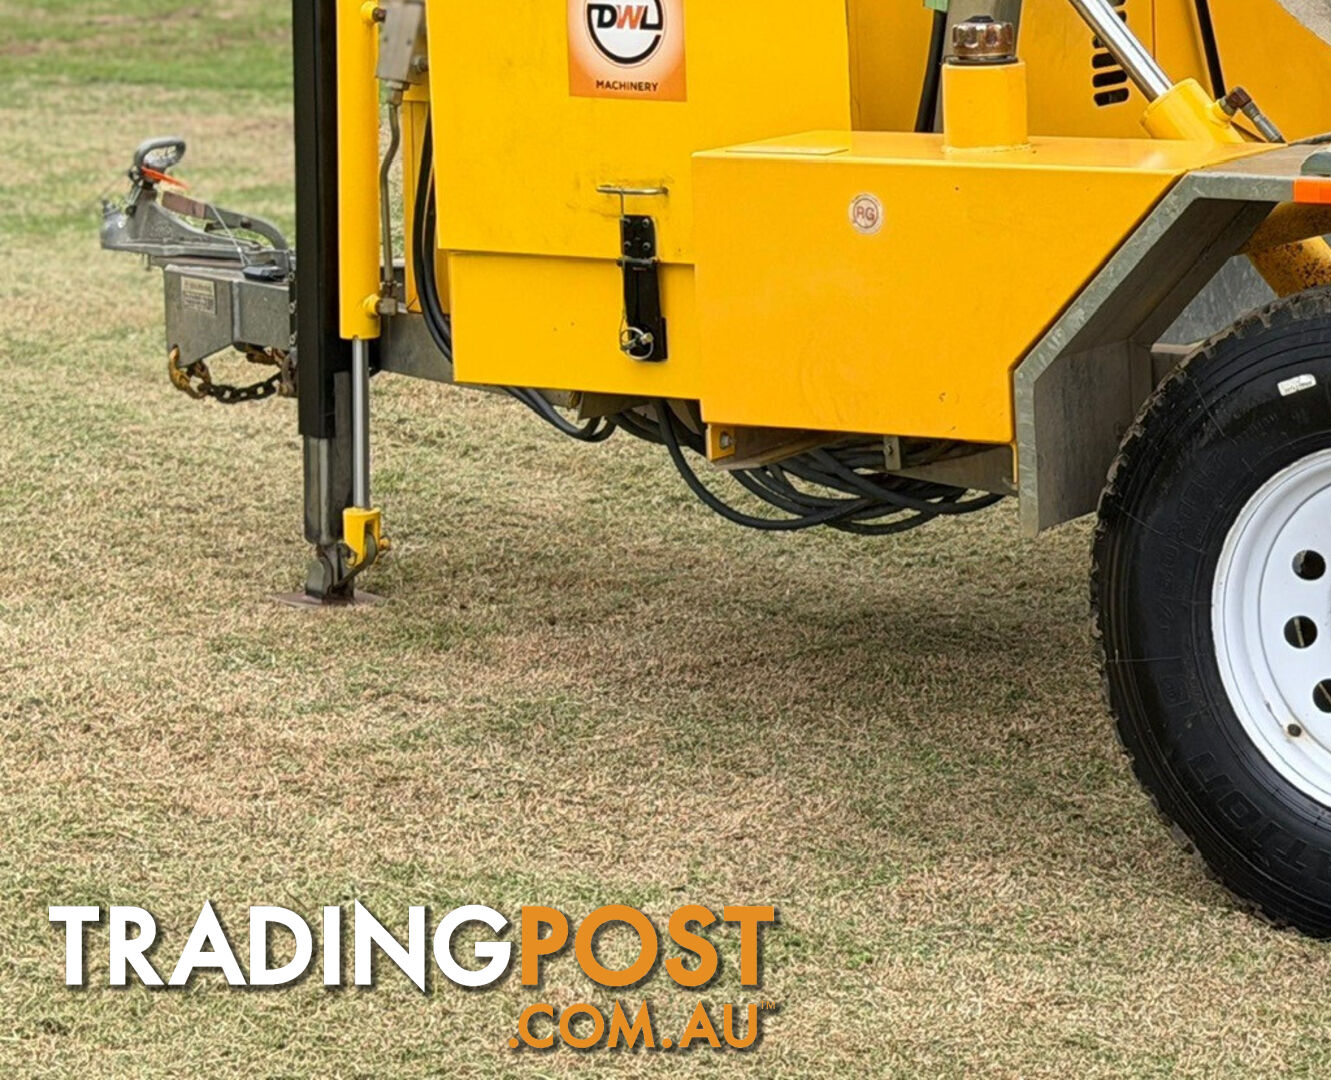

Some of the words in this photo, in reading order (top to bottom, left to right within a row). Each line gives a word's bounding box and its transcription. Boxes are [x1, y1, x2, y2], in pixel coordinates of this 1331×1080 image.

[588, 3, 663, 30] DWL
[595, 79, 659, 92] MACHINERY
[856, 205, 875, 221] RG
